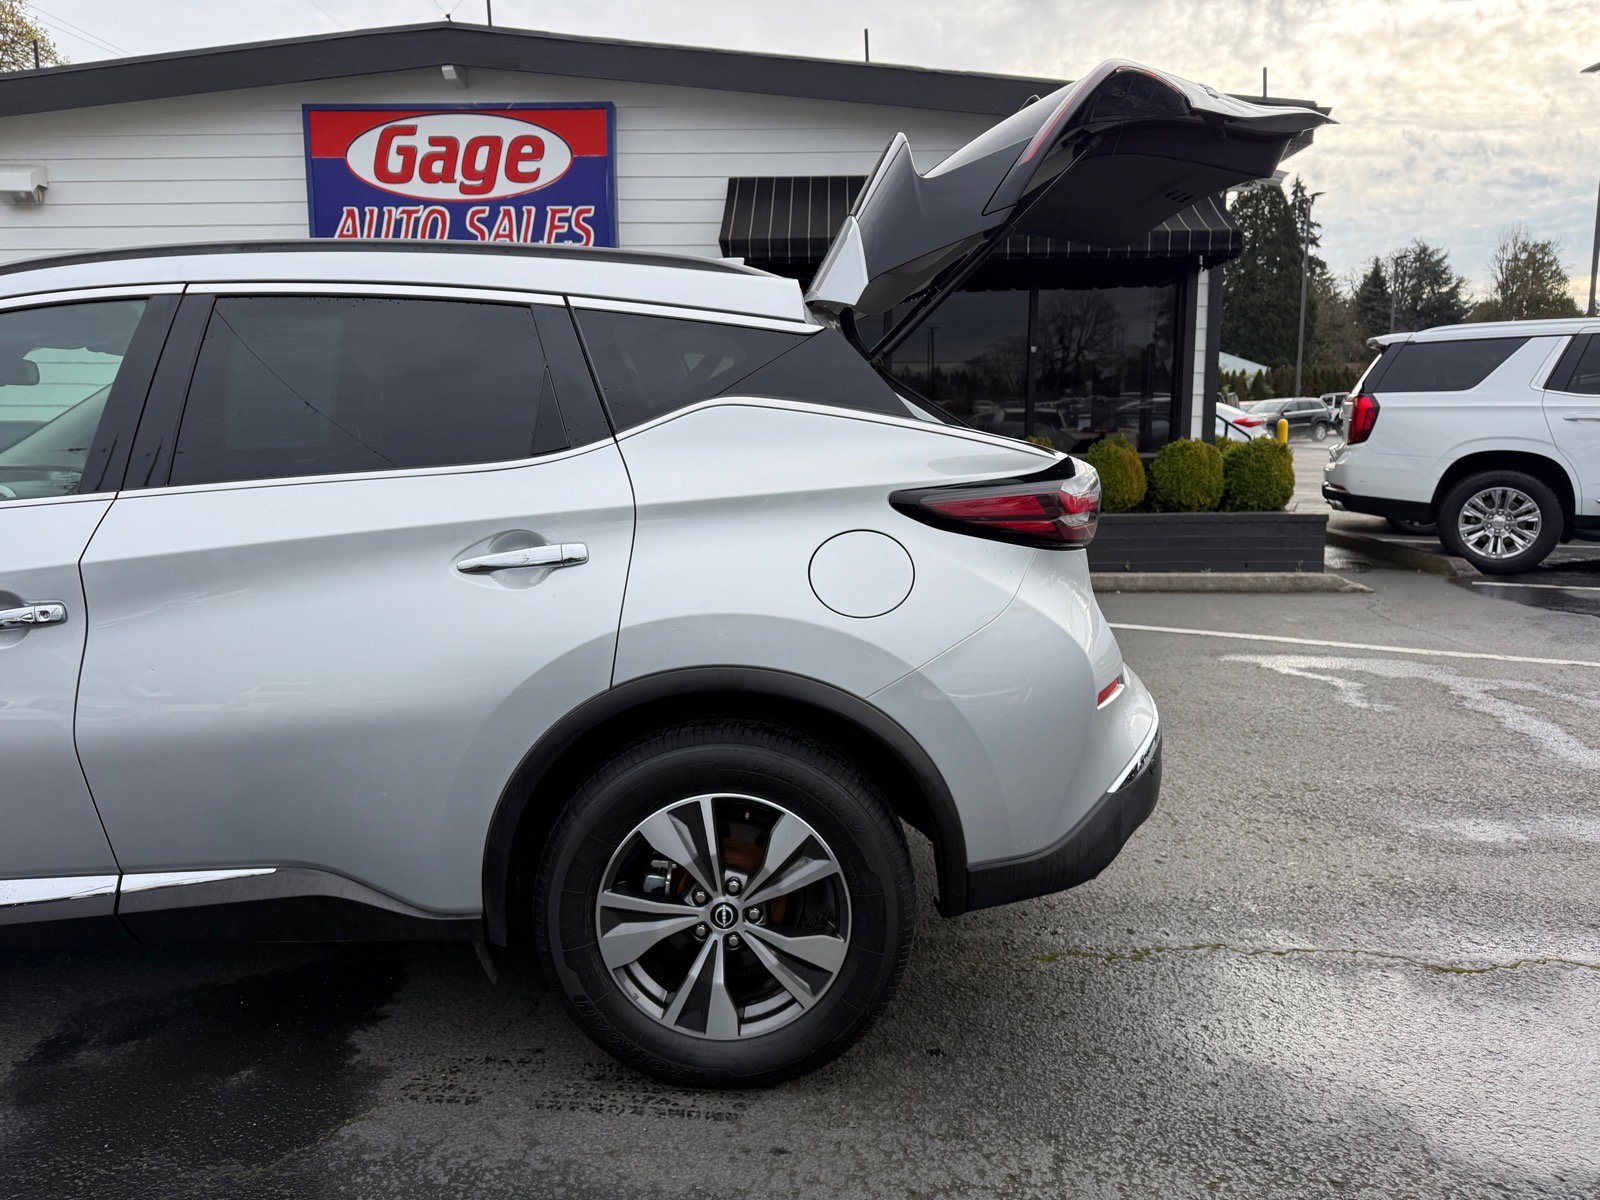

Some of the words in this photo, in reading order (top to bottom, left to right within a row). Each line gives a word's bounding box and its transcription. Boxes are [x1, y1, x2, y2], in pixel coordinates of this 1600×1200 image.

[374, 125, 545, 195] Gage
[334, 205, 450, 240] AUTO
[466, 206, 595, 247] SALES
